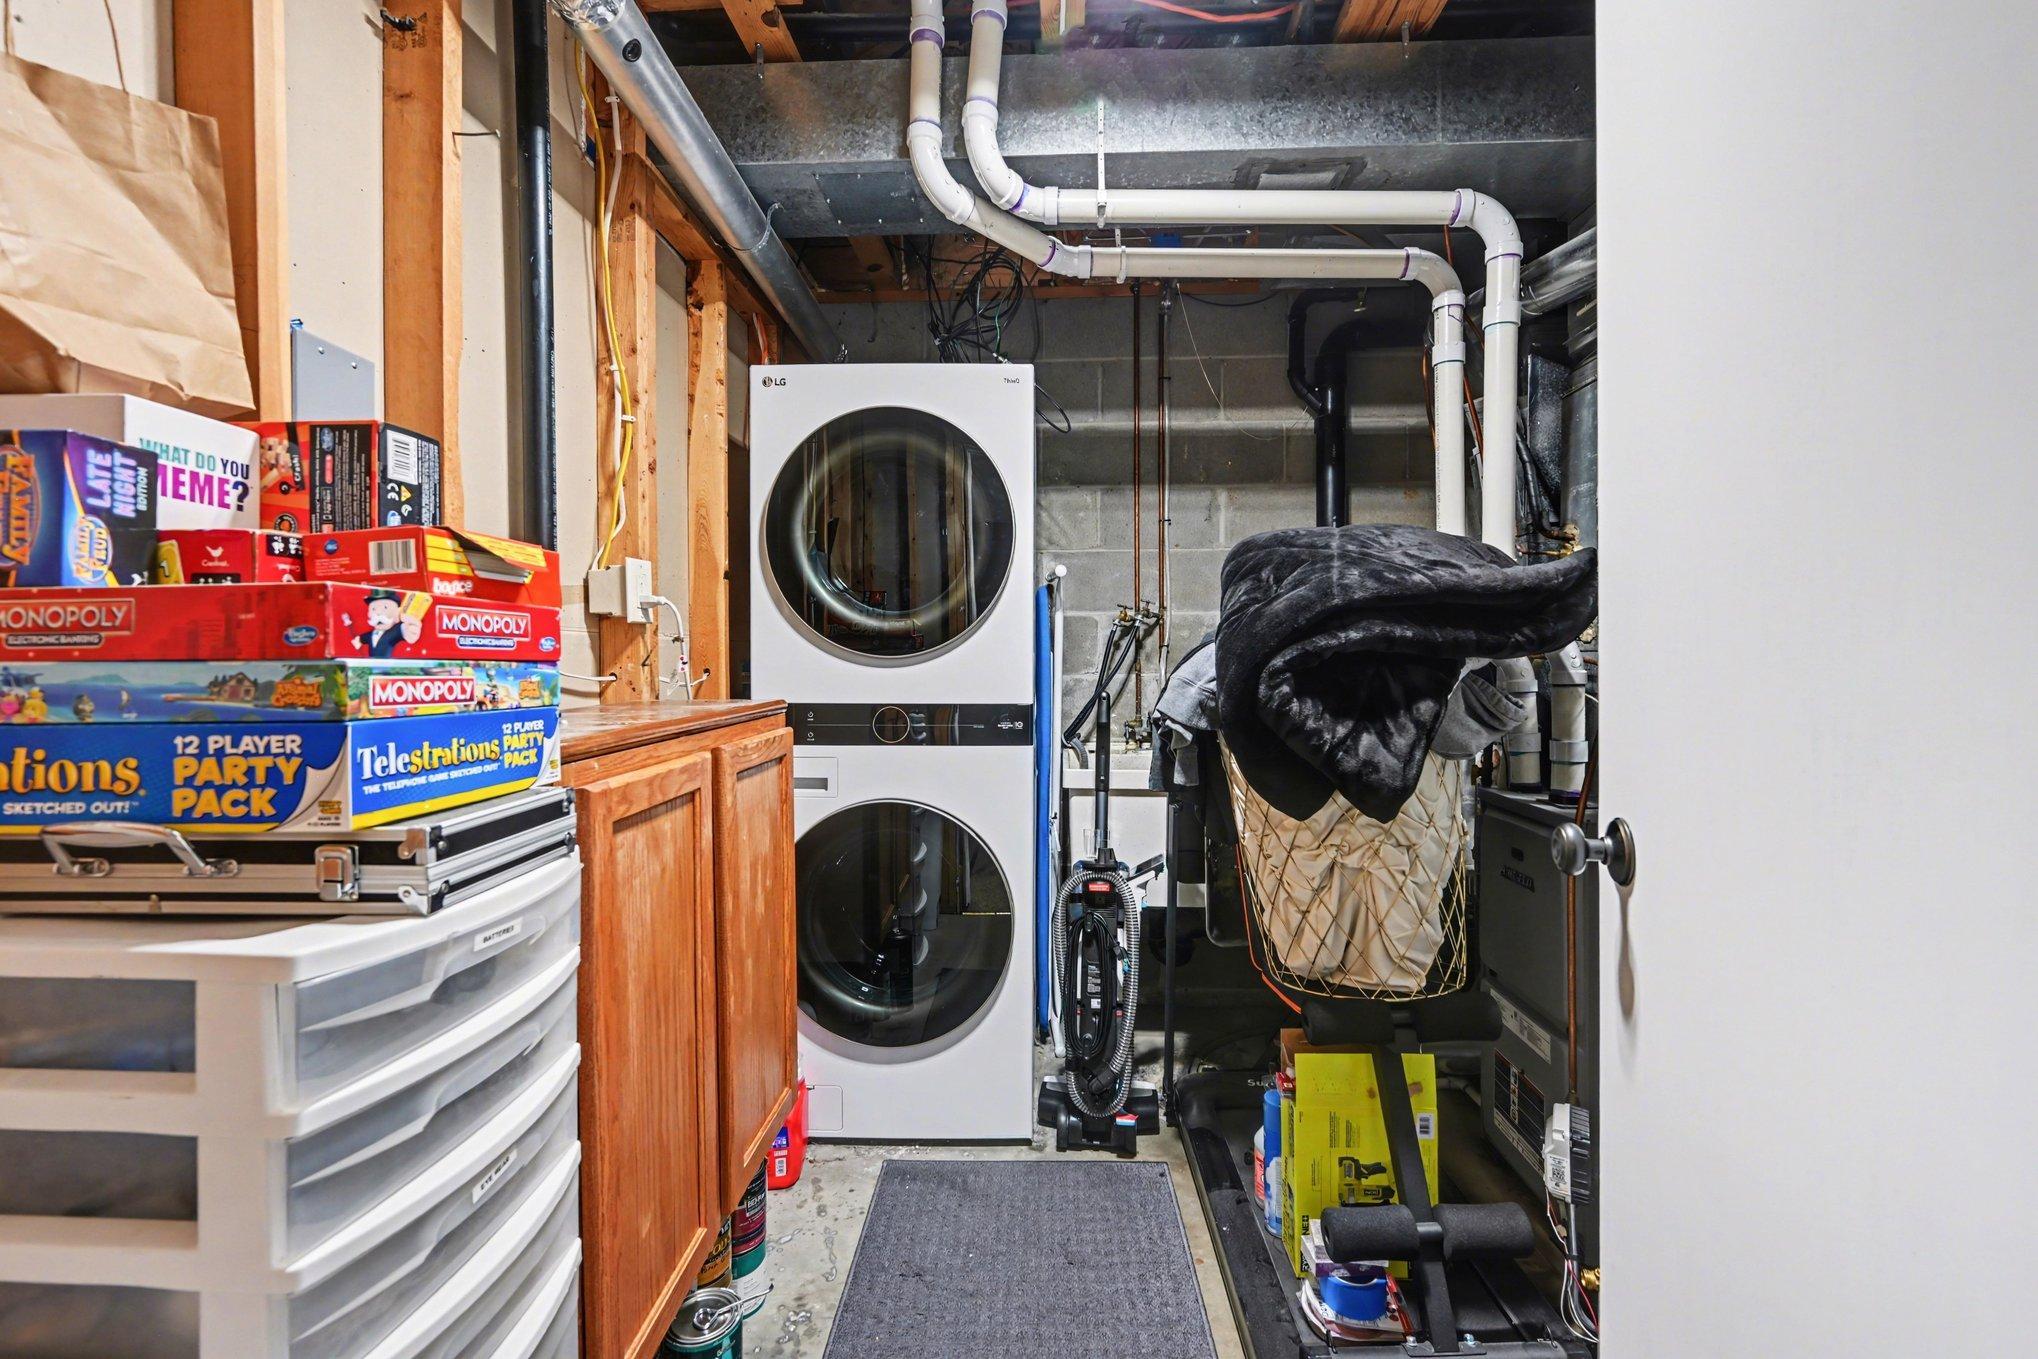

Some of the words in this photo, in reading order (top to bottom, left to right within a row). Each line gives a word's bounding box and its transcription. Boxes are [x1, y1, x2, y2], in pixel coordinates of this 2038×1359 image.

[774, 378, 787, 387] LG
[194, 451, 216, 472] DO
[220, 457, 250, 481] YOU
[86, 448, 112, 509] LATE
[112, 448, 139, 518] NIGHT
[136, 466, 149, 511] EDITION
[0, 604, 126, 630] ONOPOLY
[441, 612, 527, 635] MONOPOLY
[374, 680, 475, 702] MONOPOLY
[501, 723, 512, 732] 12
[513, 719, 545, 732] PLAYER
[173, 735, 200, 755] 12
[207, 734, 303, 755] PLAYER
[503, 731, 544, 750] PARTY
[171, 755, 303, 787] PARTY
[357, 738, 500, 780] Telestrations
[504, 749, 538, 770] PACK
[362, 784, 381, 795] THE
[382, 777, 428, 792] TELEPHONE
[427, 771, 449, 785] GAME
[2, 802, 85, 815] SKETCHED
[171, 787, 279, 819] PACK
